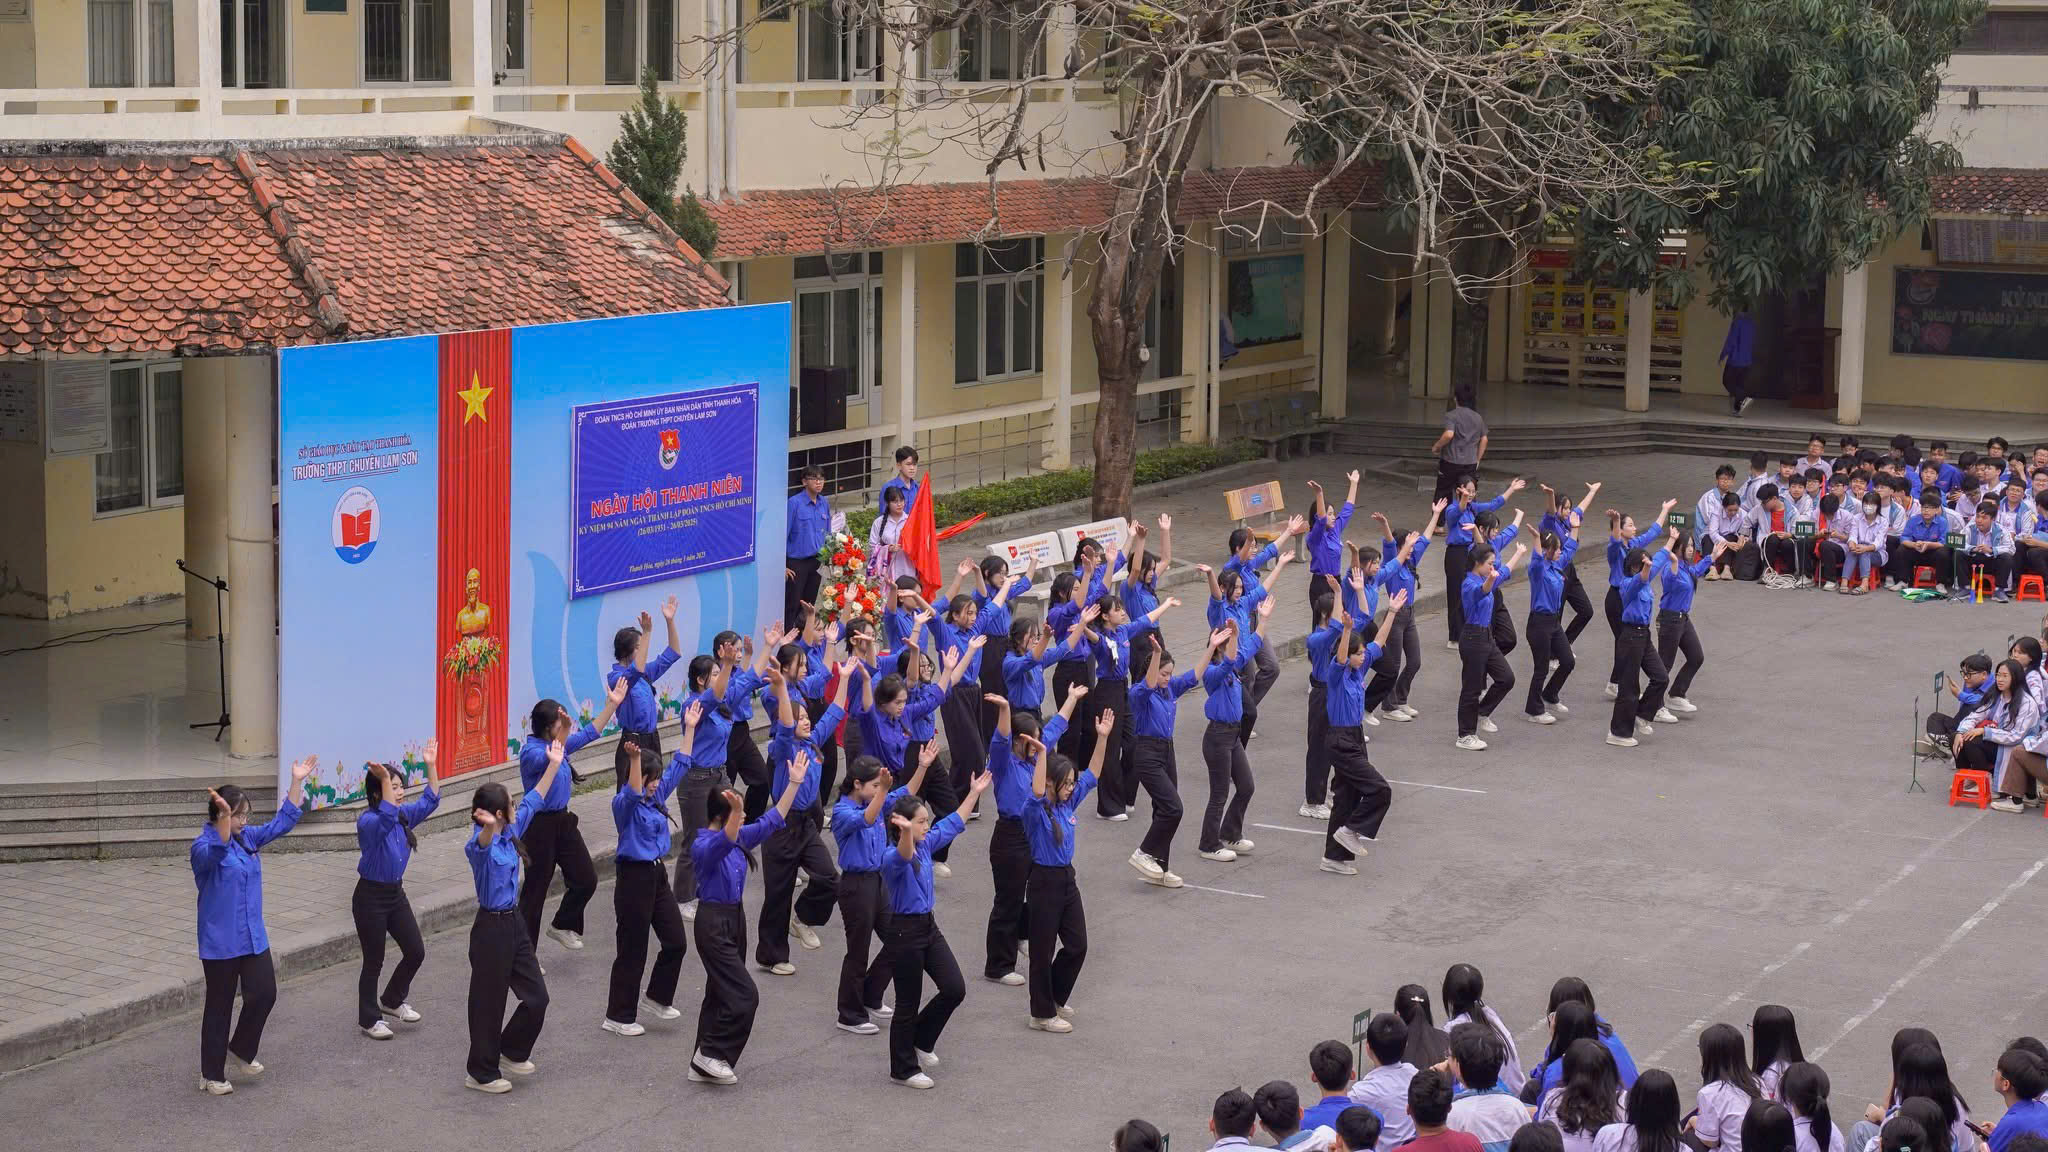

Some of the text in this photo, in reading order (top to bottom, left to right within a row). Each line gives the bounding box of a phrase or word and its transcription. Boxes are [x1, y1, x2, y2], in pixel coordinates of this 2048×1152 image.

[611, 412, 625, 422] TNCS
[643, 409, 656, 418] MINH
[665, 406, 675, 415] BAN
[714, 398, 731, 408] THANH
[660, 415, 673, 425] THPT
[674, 412, 694, 423] CHUYÊN
[695, 412, 705, 420] LAM
[706, 410, 717, 419] SƠN
[292, 449, 419, 481] TRƯỜNG THPT CHUYÊN LAM SƠN
[592, 473, 742, 519] NGÀY HỘI THANH NIÊN
[700, 503, 715, 513] TNCS
[736, 496, 752, 506] MINH
[1670, 515, 1676, 524] 12
